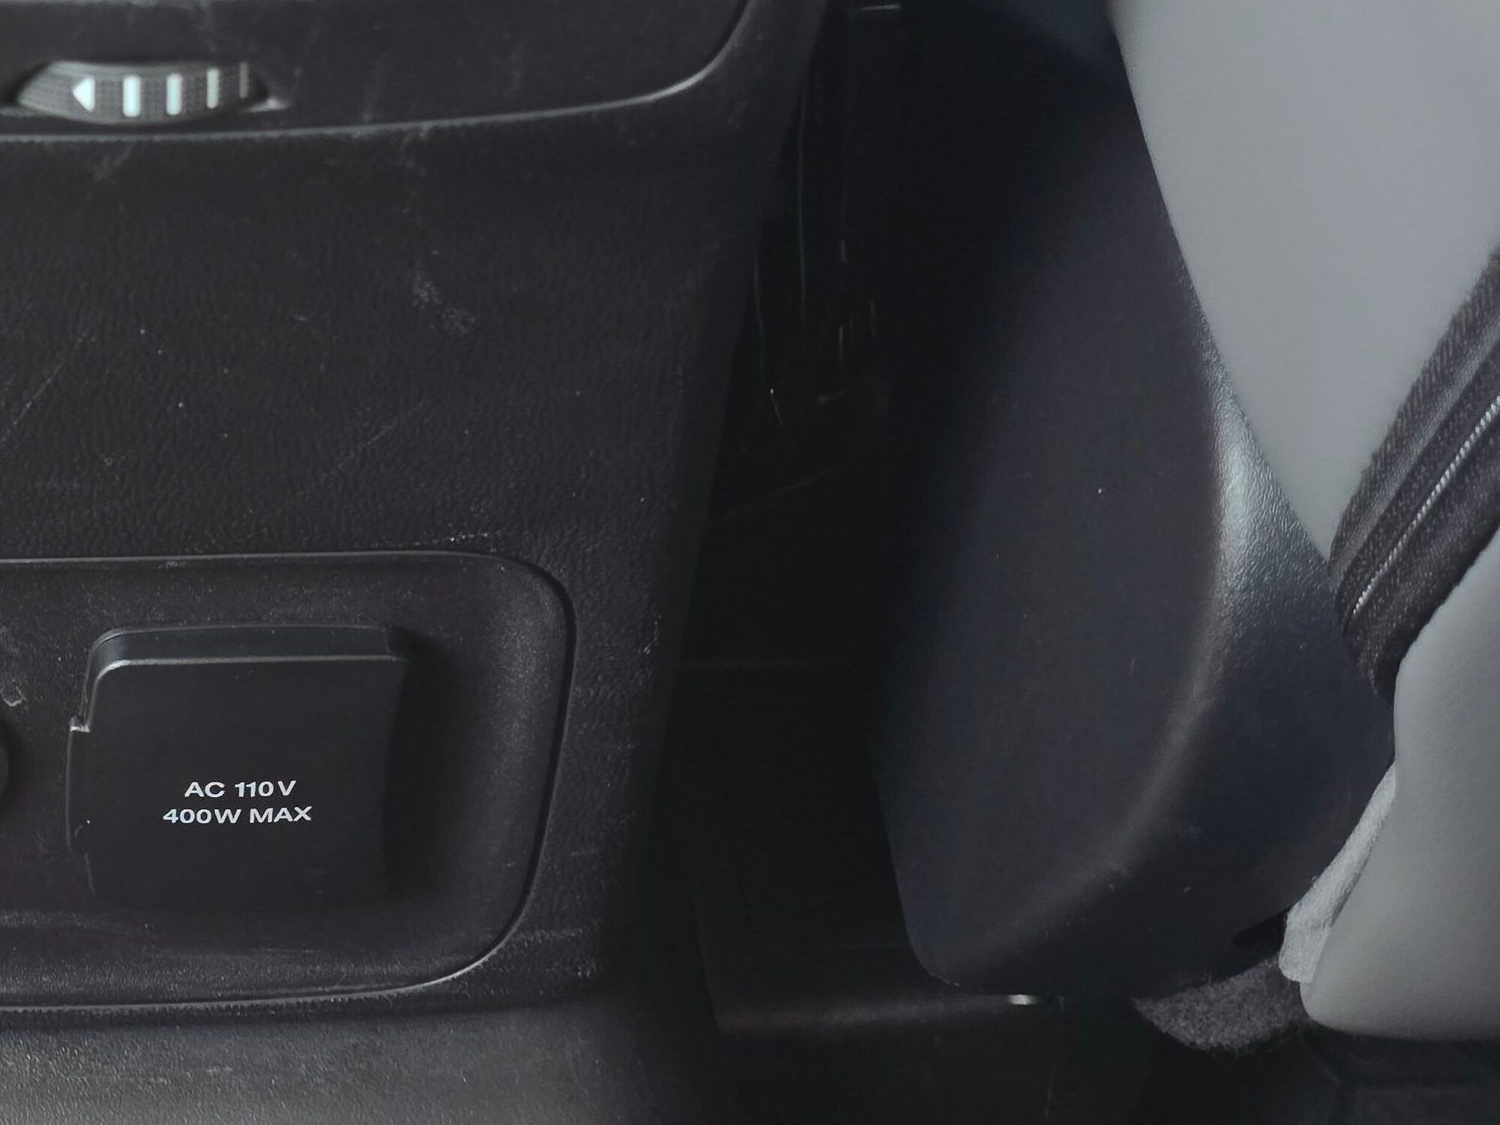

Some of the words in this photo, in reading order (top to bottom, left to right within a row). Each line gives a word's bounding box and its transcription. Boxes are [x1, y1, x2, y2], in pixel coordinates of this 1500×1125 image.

[184, 780, 226, 798] AC
[162, 807, 242, 824] 400W
[249, 805, 313, 824] MAX
